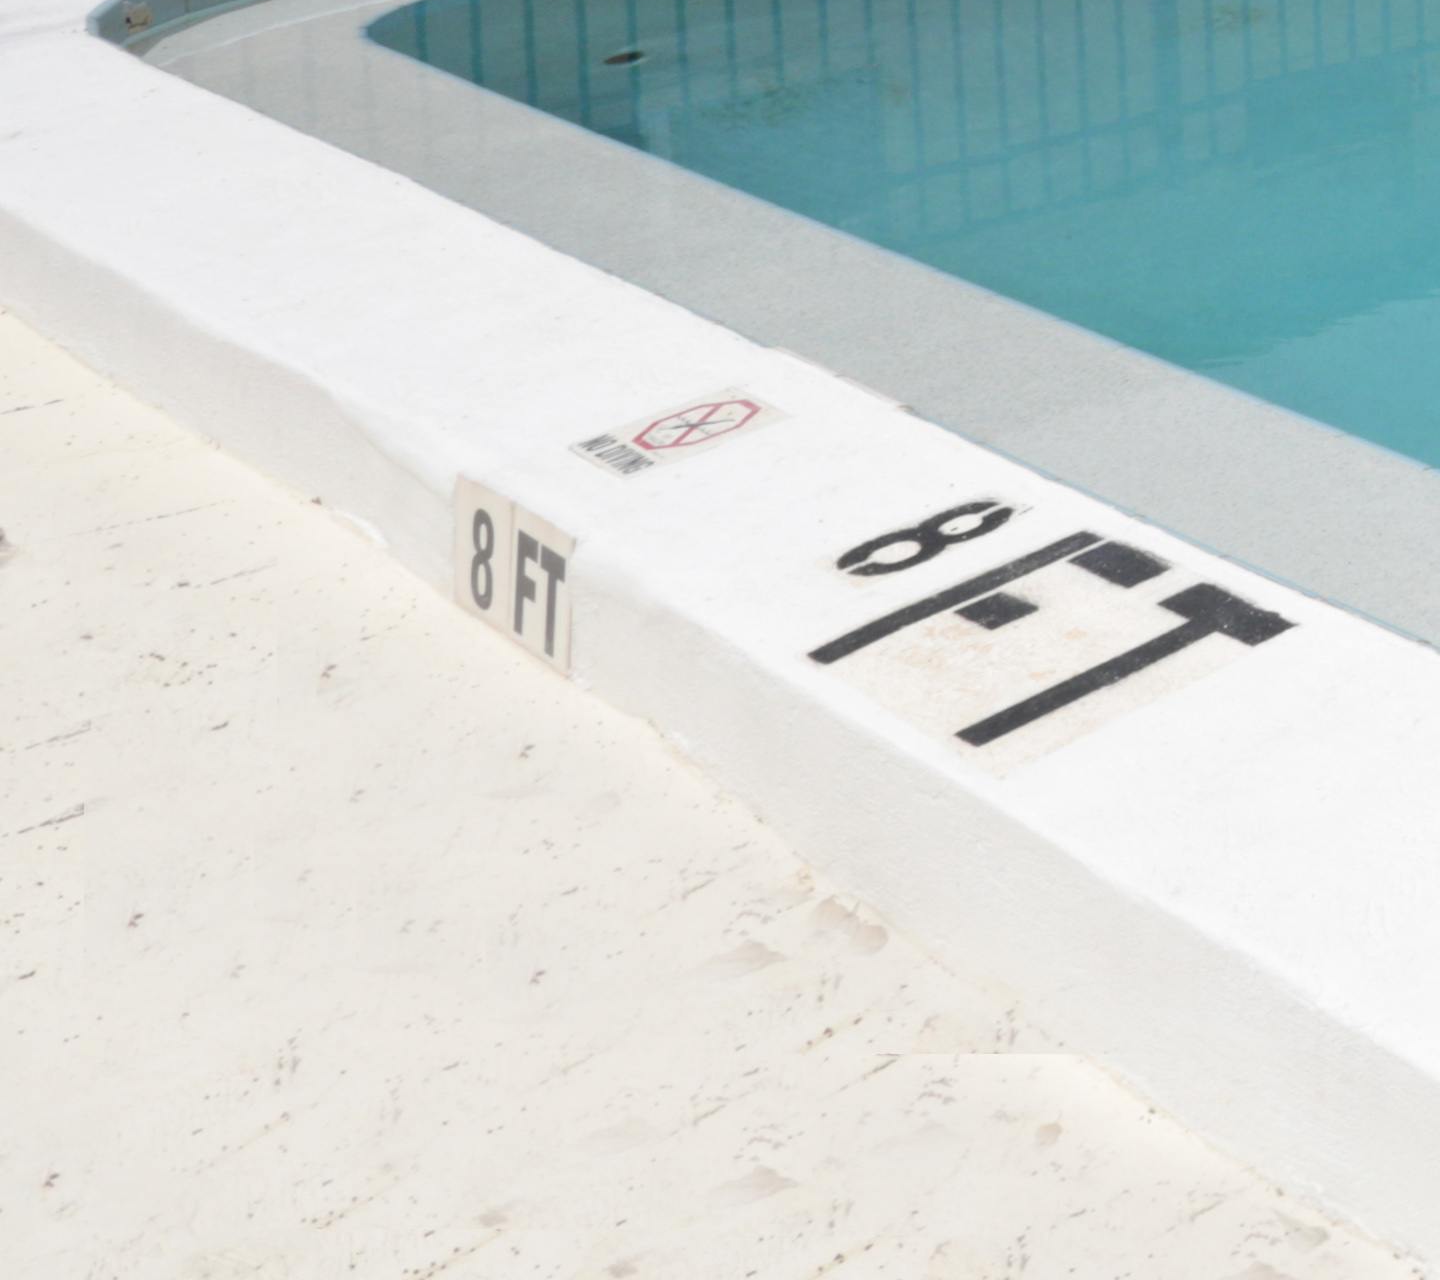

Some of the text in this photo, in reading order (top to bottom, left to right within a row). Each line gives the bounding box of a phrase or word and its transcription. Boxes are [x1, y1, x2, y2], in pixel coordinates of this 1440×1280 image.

[577, 433, 655, 475] NO DIVING
[471, 508, 567, 658] 8 FT
[807, 500, 1299, 747] 8 FT
